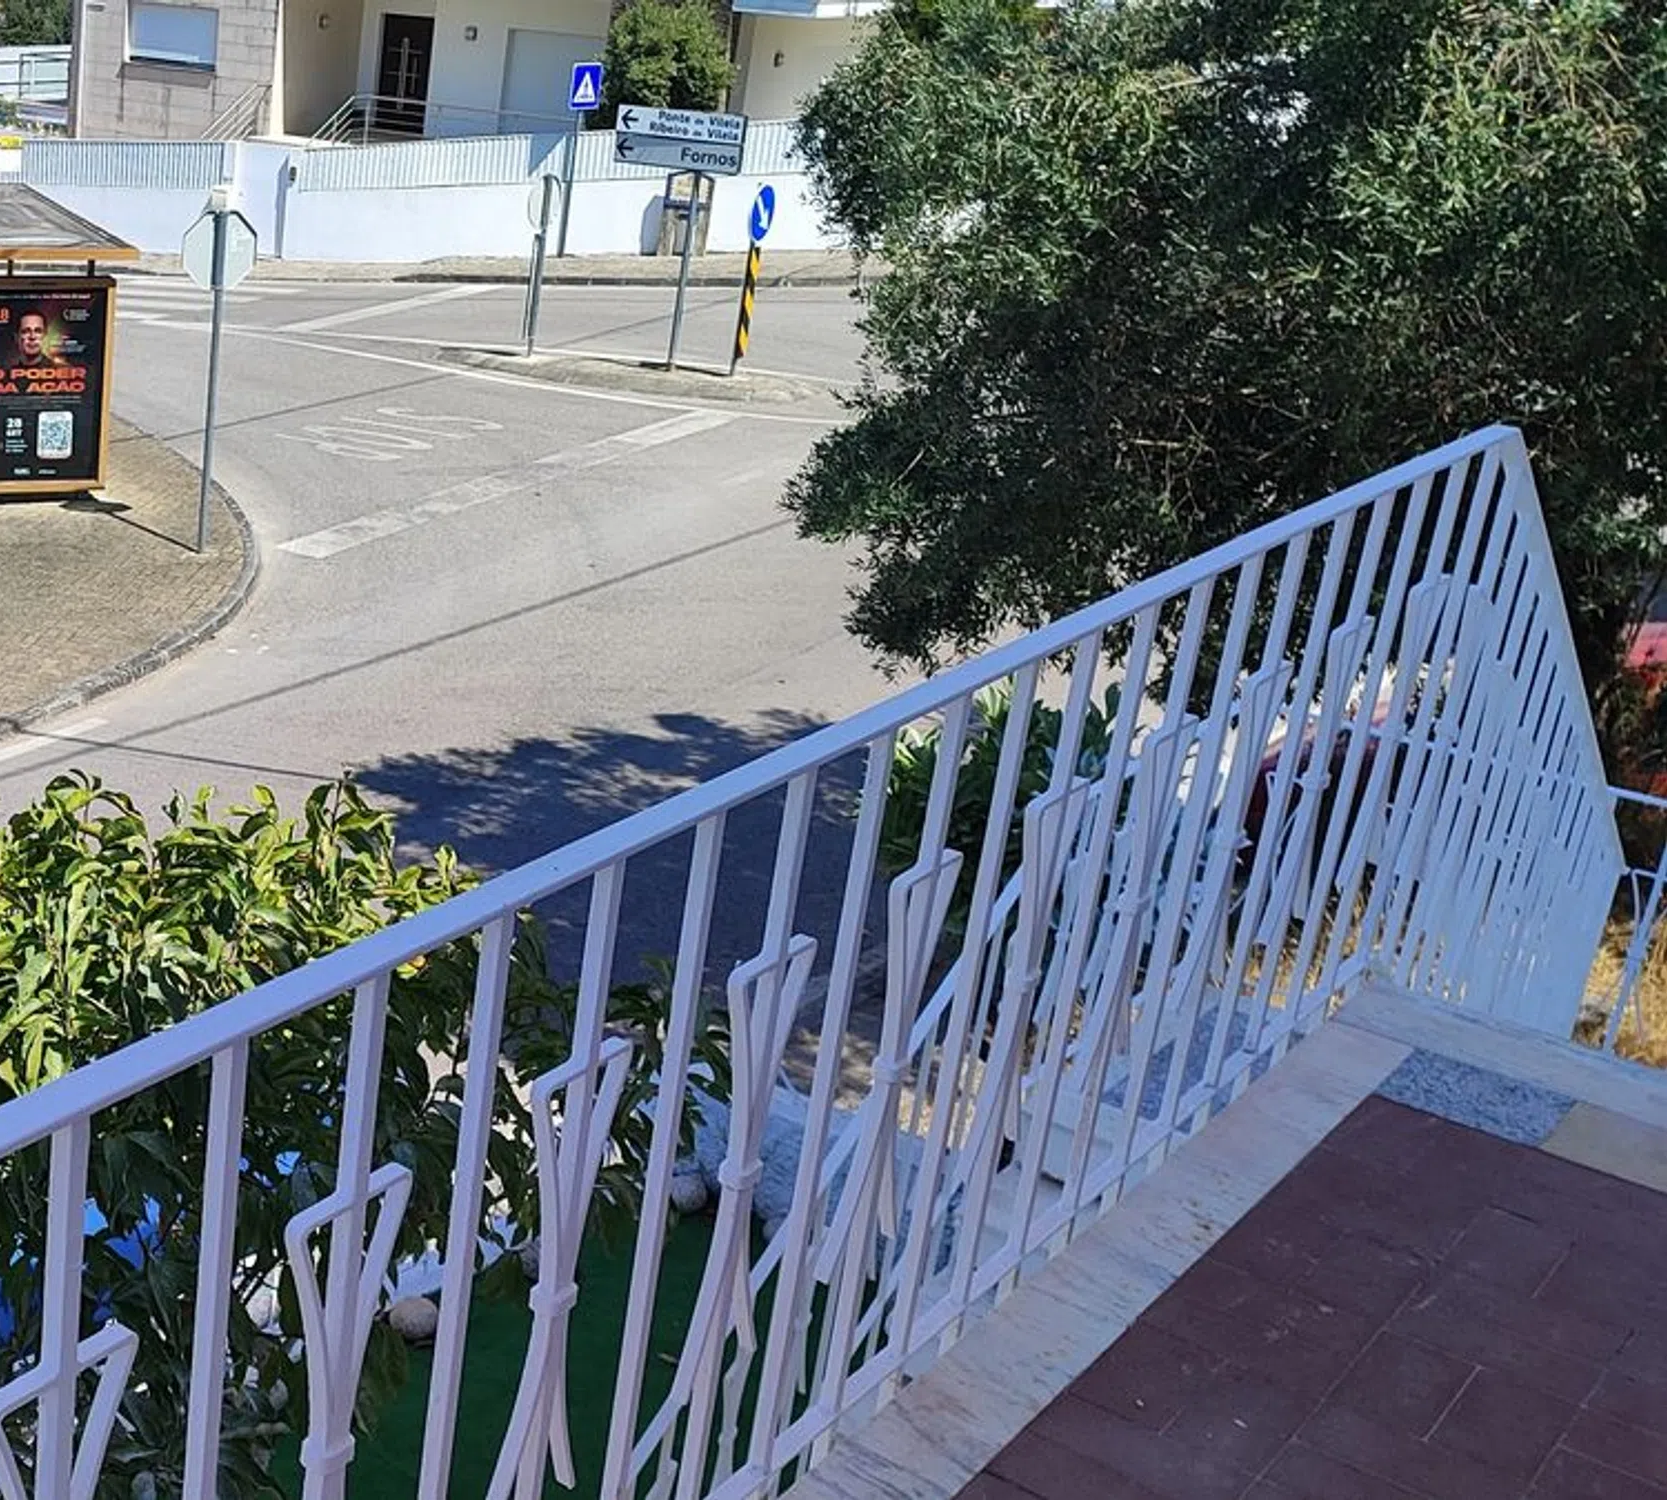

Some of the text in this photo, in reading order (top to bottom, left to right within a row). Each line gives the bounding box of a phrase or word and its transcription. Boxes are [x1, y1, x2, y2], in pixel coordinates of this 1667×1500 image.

[658, 110, 690, 123] Ponte
[649, 121, 690, 136] Ribeiro
[680, 147, 737, 167] Fornos
[10, 367, 87, 380] PODER
[5, 418, 23, 428] 28
